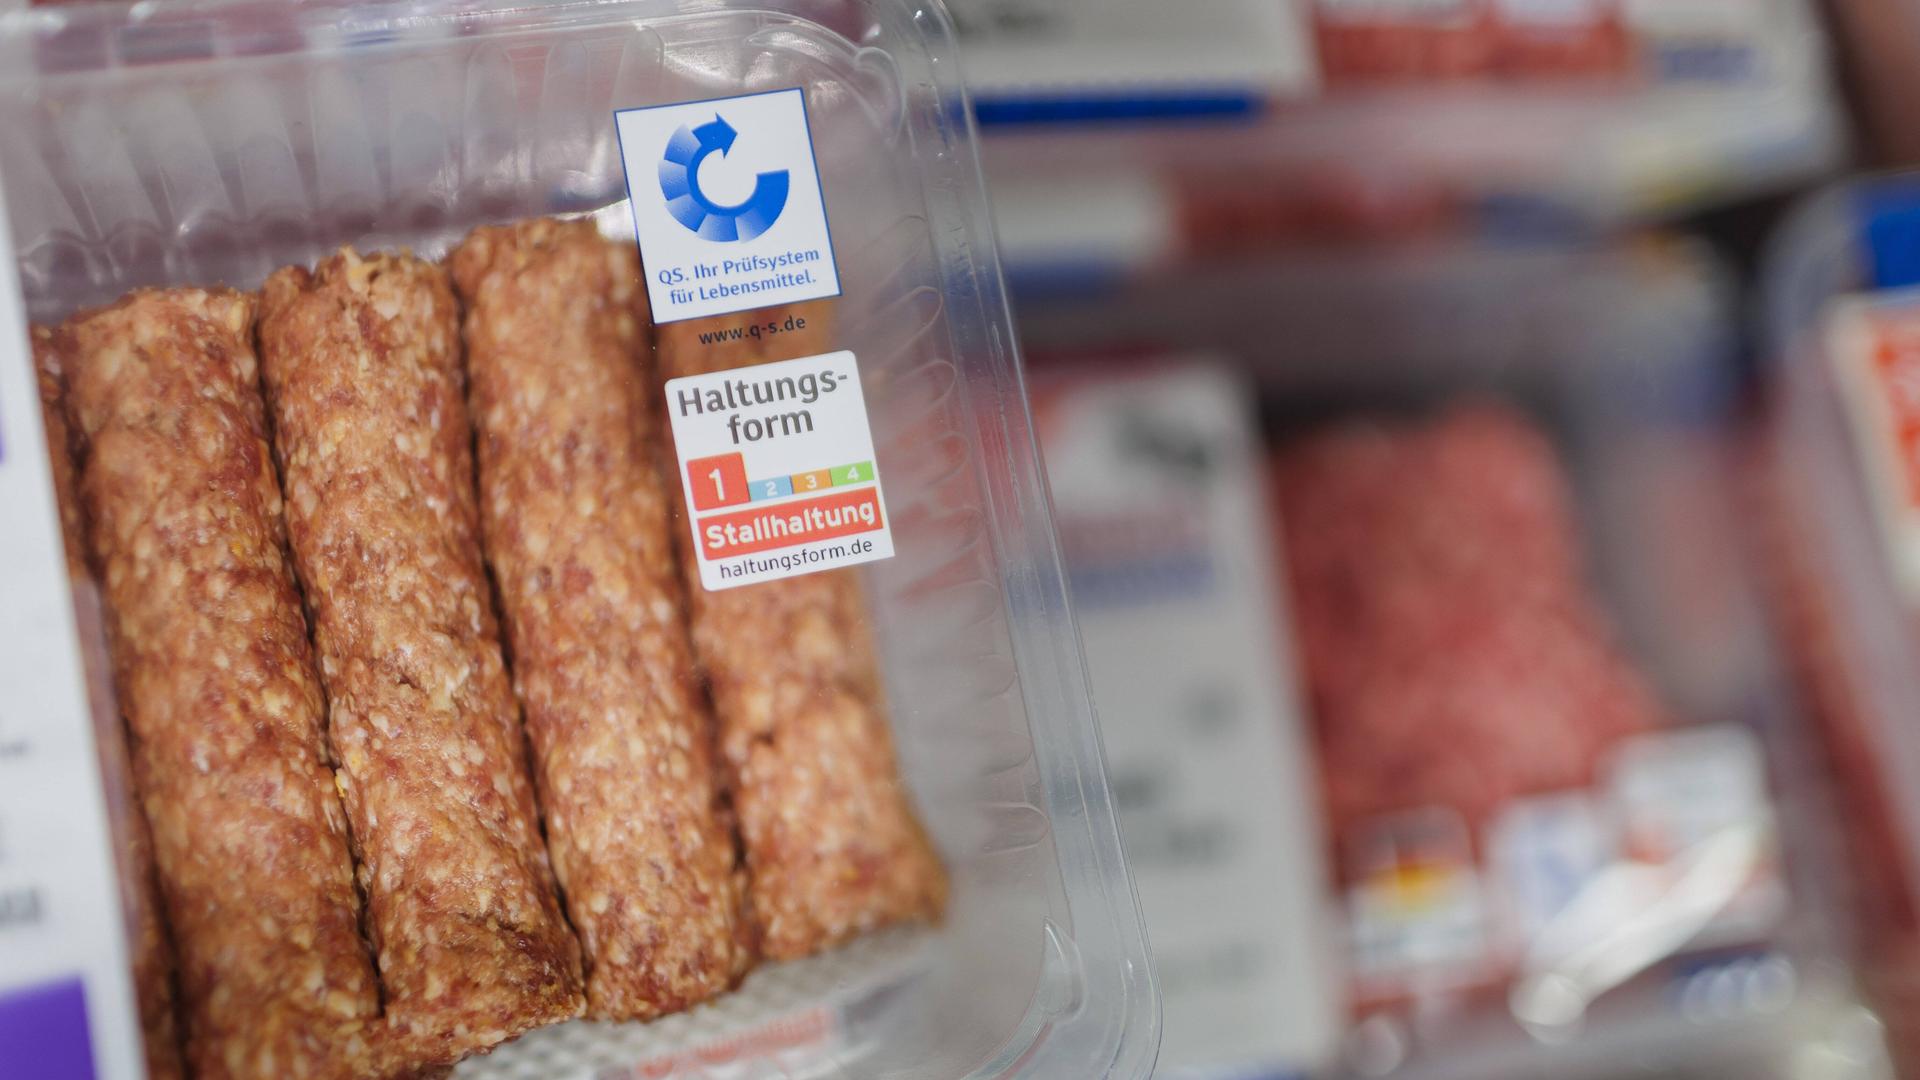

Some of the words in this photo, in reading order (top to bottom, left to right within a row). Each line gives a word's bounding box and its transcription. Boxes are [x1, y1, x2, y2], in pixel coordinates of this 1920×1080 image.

[658, 267, 690, 286] QS.
[694, 263, 718, 280] Ihr
[723, 249, 820, 275] Prüfsystem
[670, 289, 695, 305] für
[699, 270, 817, 300] Lebensmittel.
[698, 315, 806, 345] www.q-s.de
[677, 369, 848, 417] Haltungs-
[727, 409, 814, 445] form
[708, 468, 725, 501] 1
[766, 481, 778, 496] 2
[806, 474, 817, 489] 3
[847, 467, 859, 481] 4
[705, 501, 875, 549] Stallhaltung
[719, 538, 873, 579] haltungsform.de
